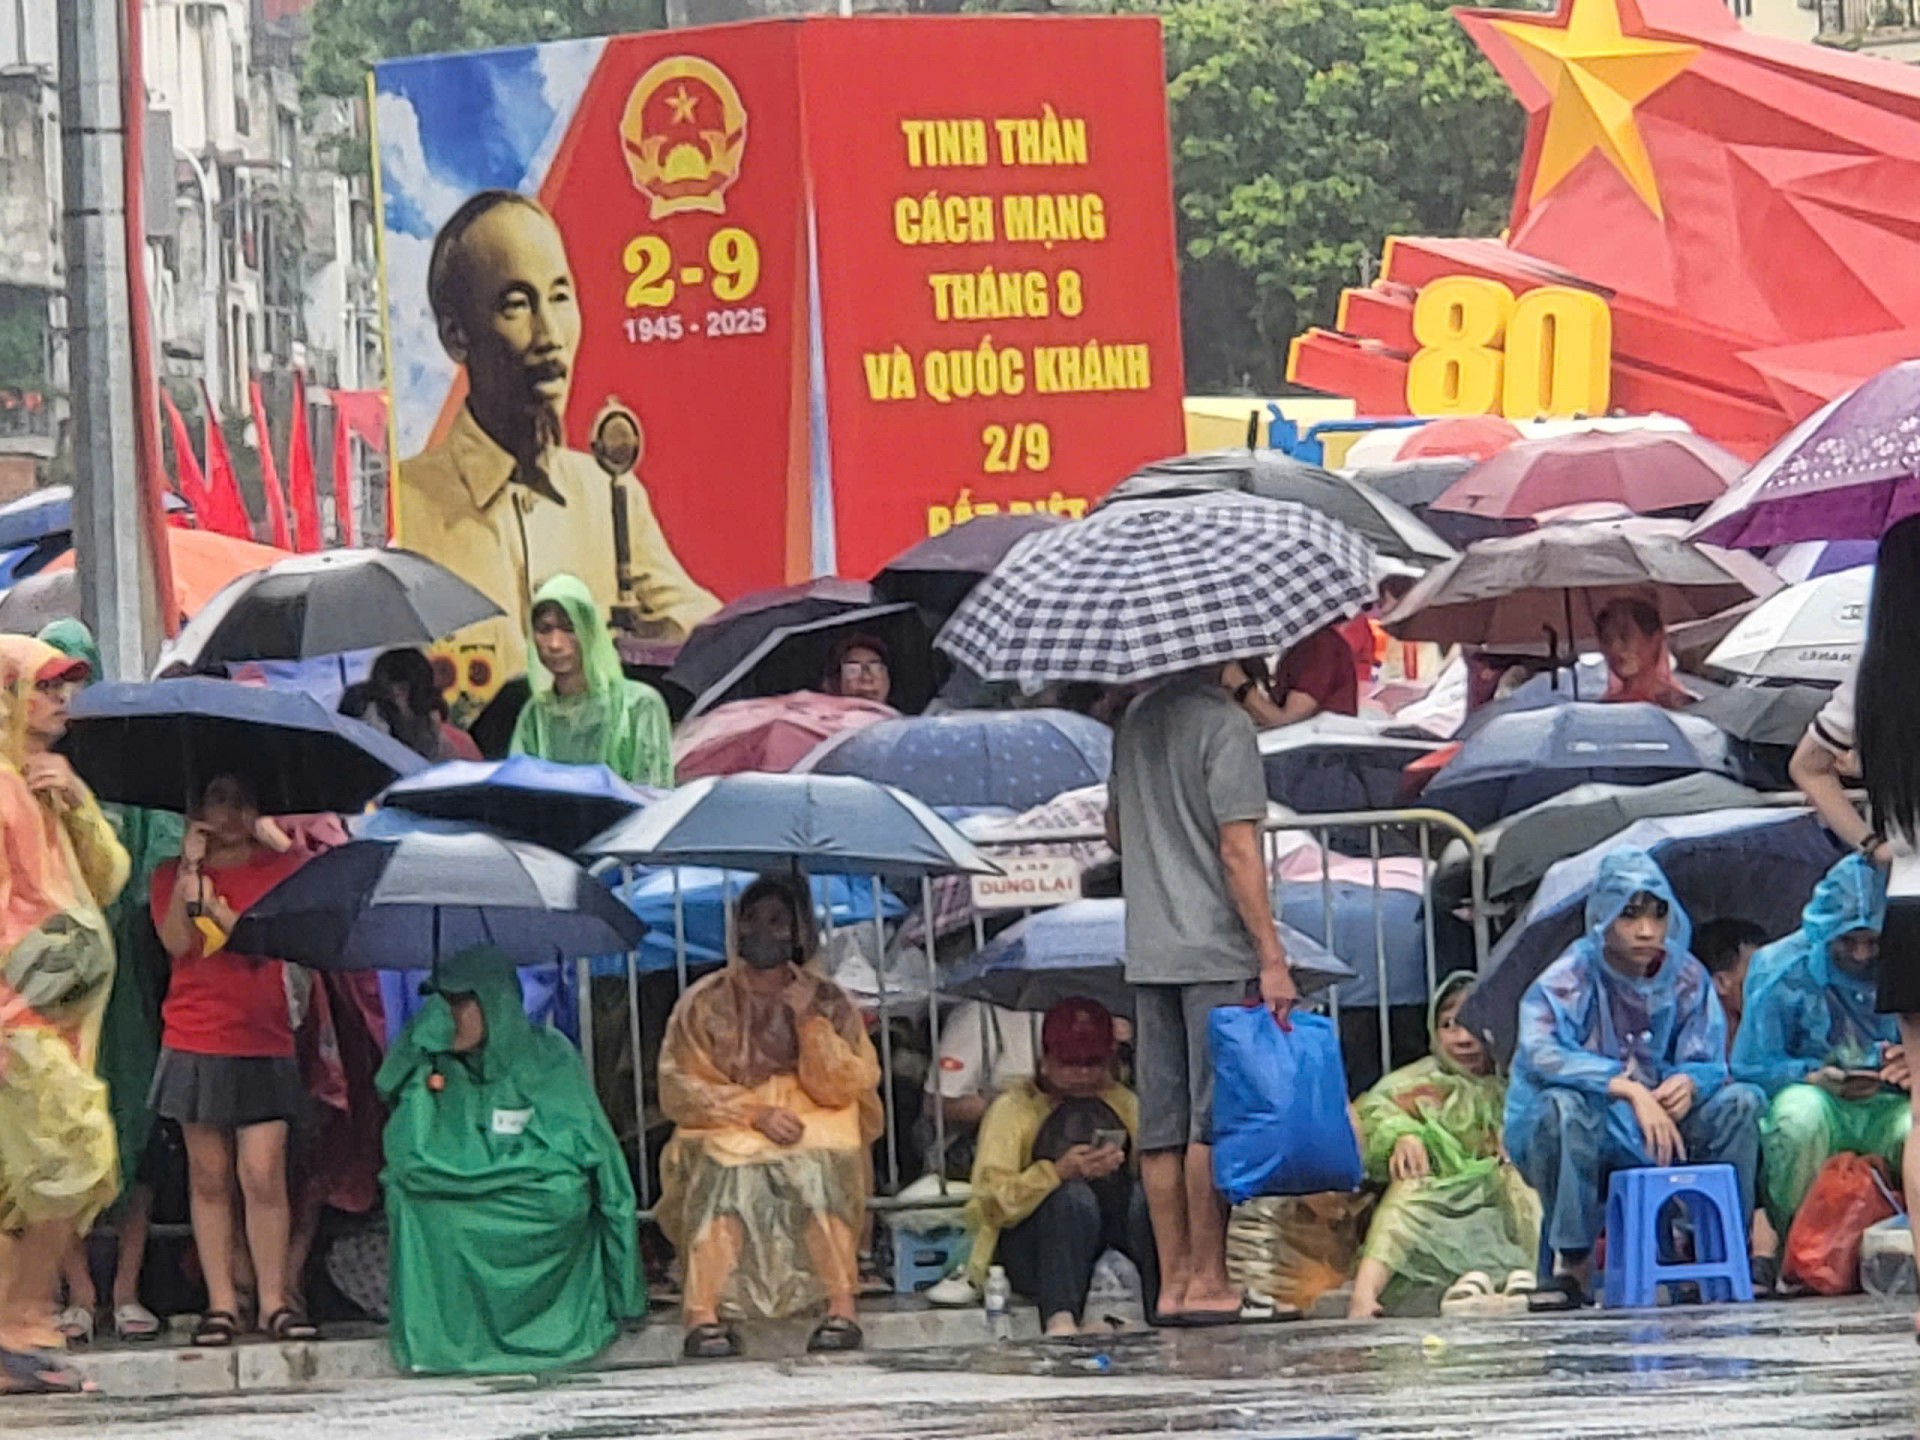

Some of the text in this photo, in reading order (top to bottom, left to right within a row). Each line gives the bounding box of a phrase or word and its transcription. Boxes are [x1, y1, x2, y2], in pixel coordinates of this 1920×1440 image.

[901, 118, 988, 167] TINH
[894, 190, 1106, 250] CÁCH MẠNG
[622, 227, 760, 309] 2-9
[928, 265, 1083, 321] THÁNG 8
[624, 314, 684, 342] 1945
[706, 307, 767, 337] 2025
[1406, 274, 1613, 420] 80
[863, 345, 917, 401] VÀ
[1033, 338, 1151, 393] KHÁNH
[982, 422, 1050, 473] 2/9
